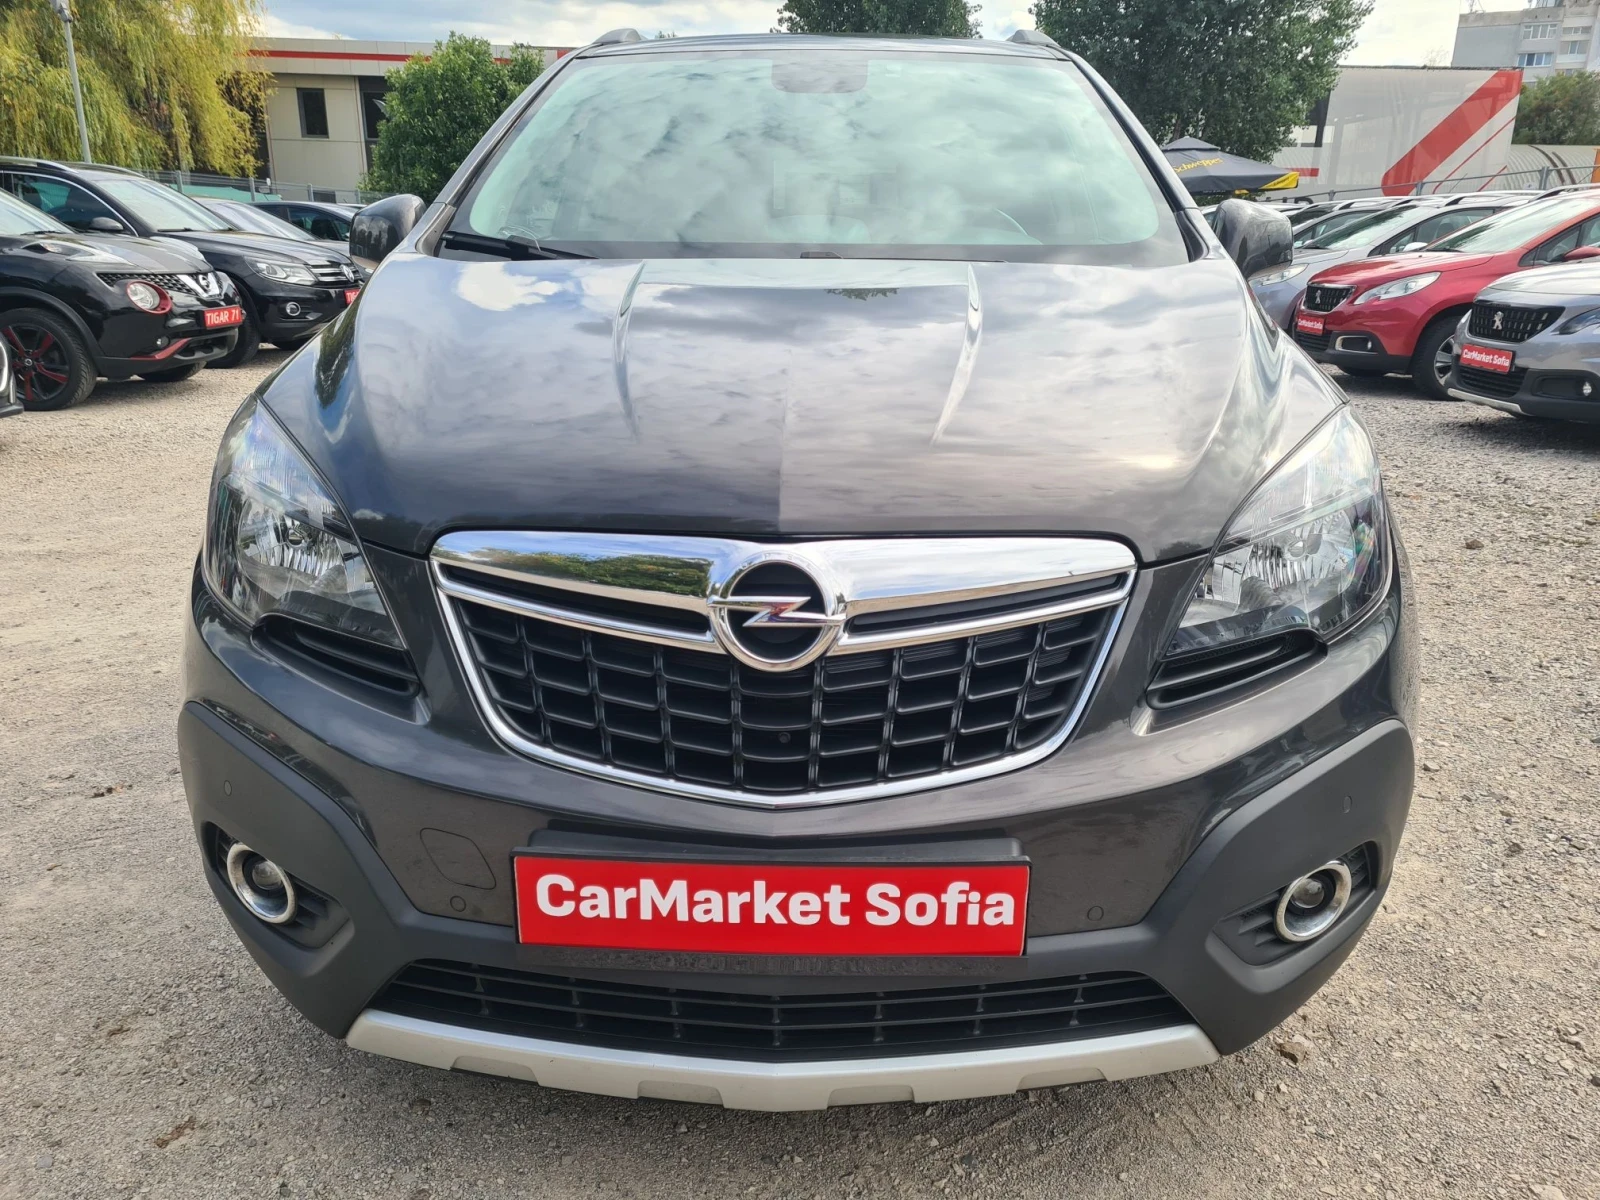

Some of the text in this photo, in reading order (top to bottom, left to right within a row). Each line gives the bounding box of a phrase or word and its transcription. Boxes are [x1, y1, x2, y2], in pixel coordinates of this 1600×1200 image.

[206, 309, 239, 325] TIGAR 71
[1463, 349, 1509, 366] CarMarket Sofia
[535, 873, 1015, 927] CarMarket Sofia
